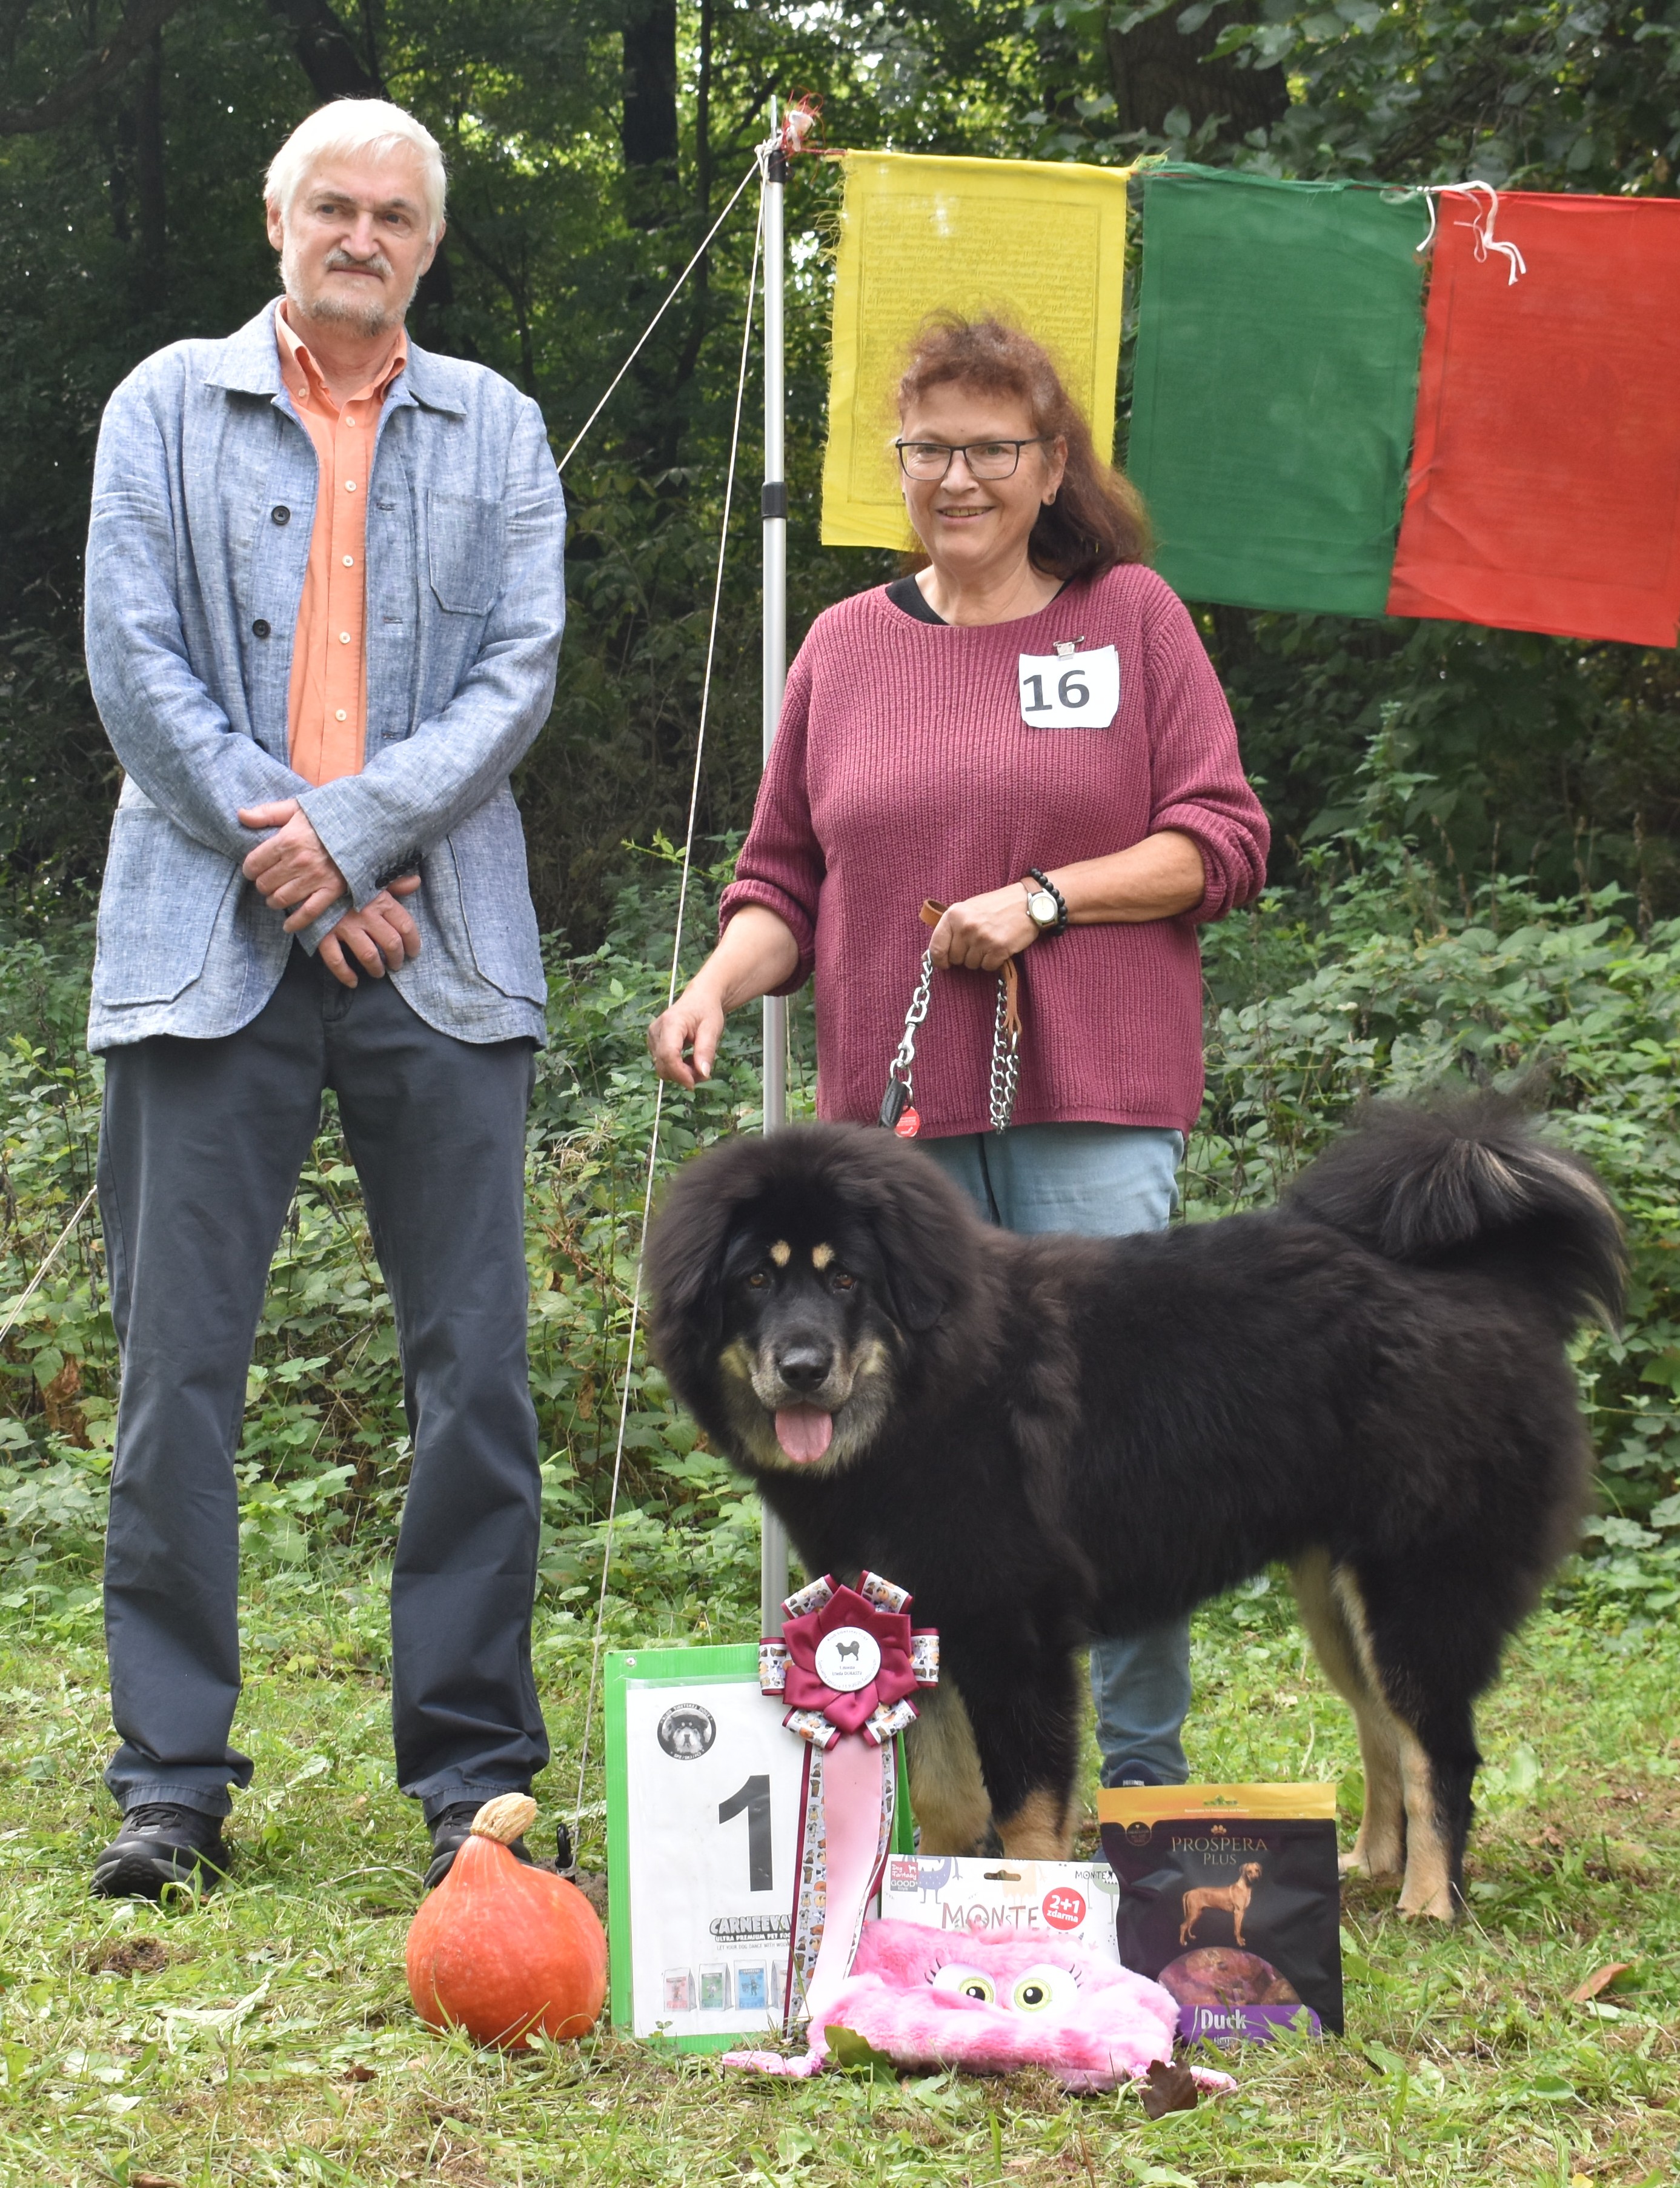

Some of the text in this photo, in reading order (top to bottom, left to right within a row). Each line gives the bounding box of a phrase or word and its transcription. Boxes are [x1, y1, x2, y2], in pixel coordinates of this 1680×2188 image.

[1023, 670, 1090, 712] 16
[718, 1774, 773, 1892] 1
[1171, 1837, 1269, 1852] PROSPERA
[1204, 1852, 1237, 1864] PLUS
[1049, 1895, 1080, 1914] 2+1
[942, 1902, 1040, 1930] MONSTE
[1047, 1909, 1078, 1923] zdarma
[1201, 2009, 1247, 2029] Duck
